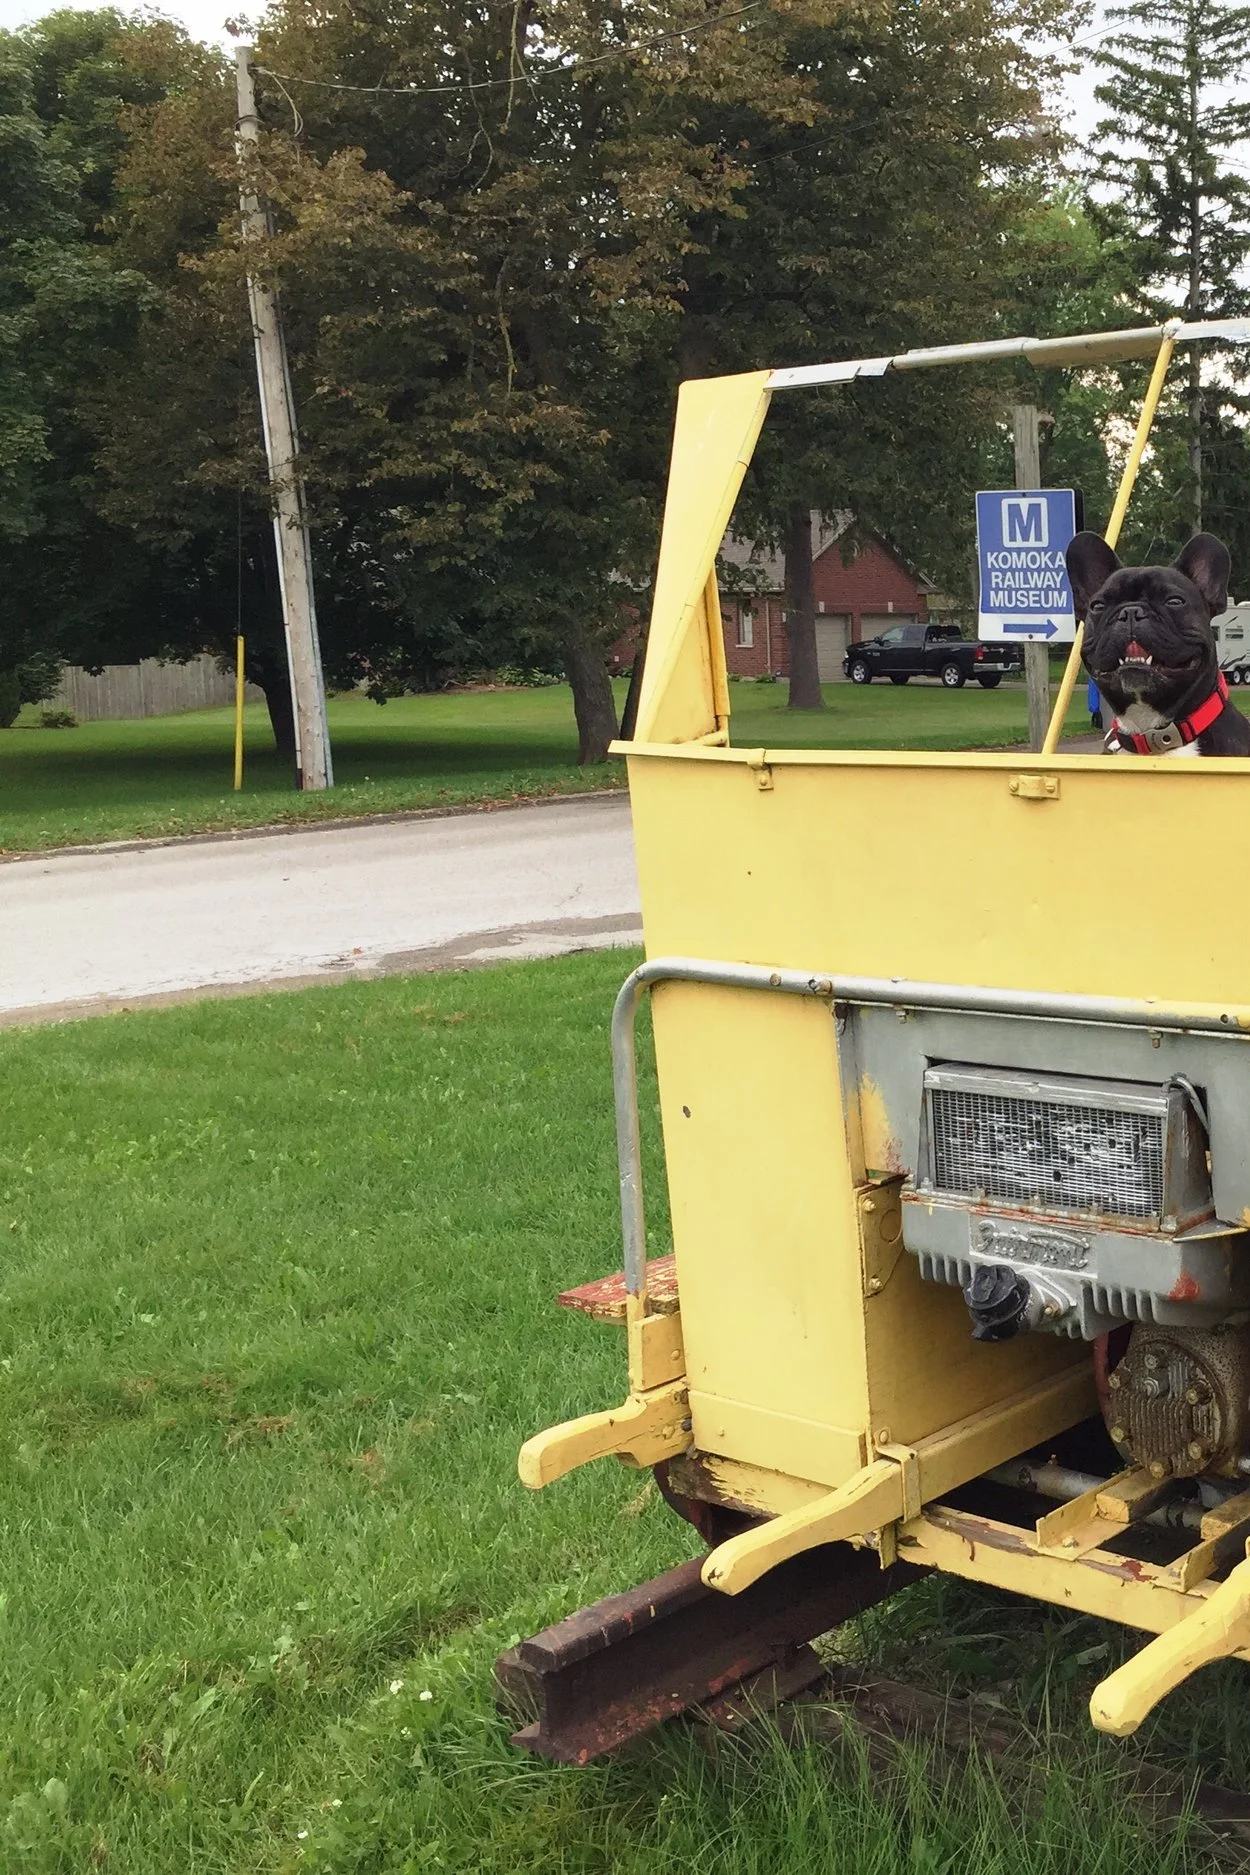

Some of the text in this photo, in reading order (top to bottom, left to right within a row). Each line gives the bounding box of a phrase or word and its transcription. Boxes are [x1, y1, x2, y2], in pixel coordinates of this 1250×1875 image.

[1007, 503, 1043, 543] M
[987, 551, 1067, 569] KOMOKA
[991, 571, 1064, 589] RAILWAY
[989, 590, 1068, 608] MUSEUM
